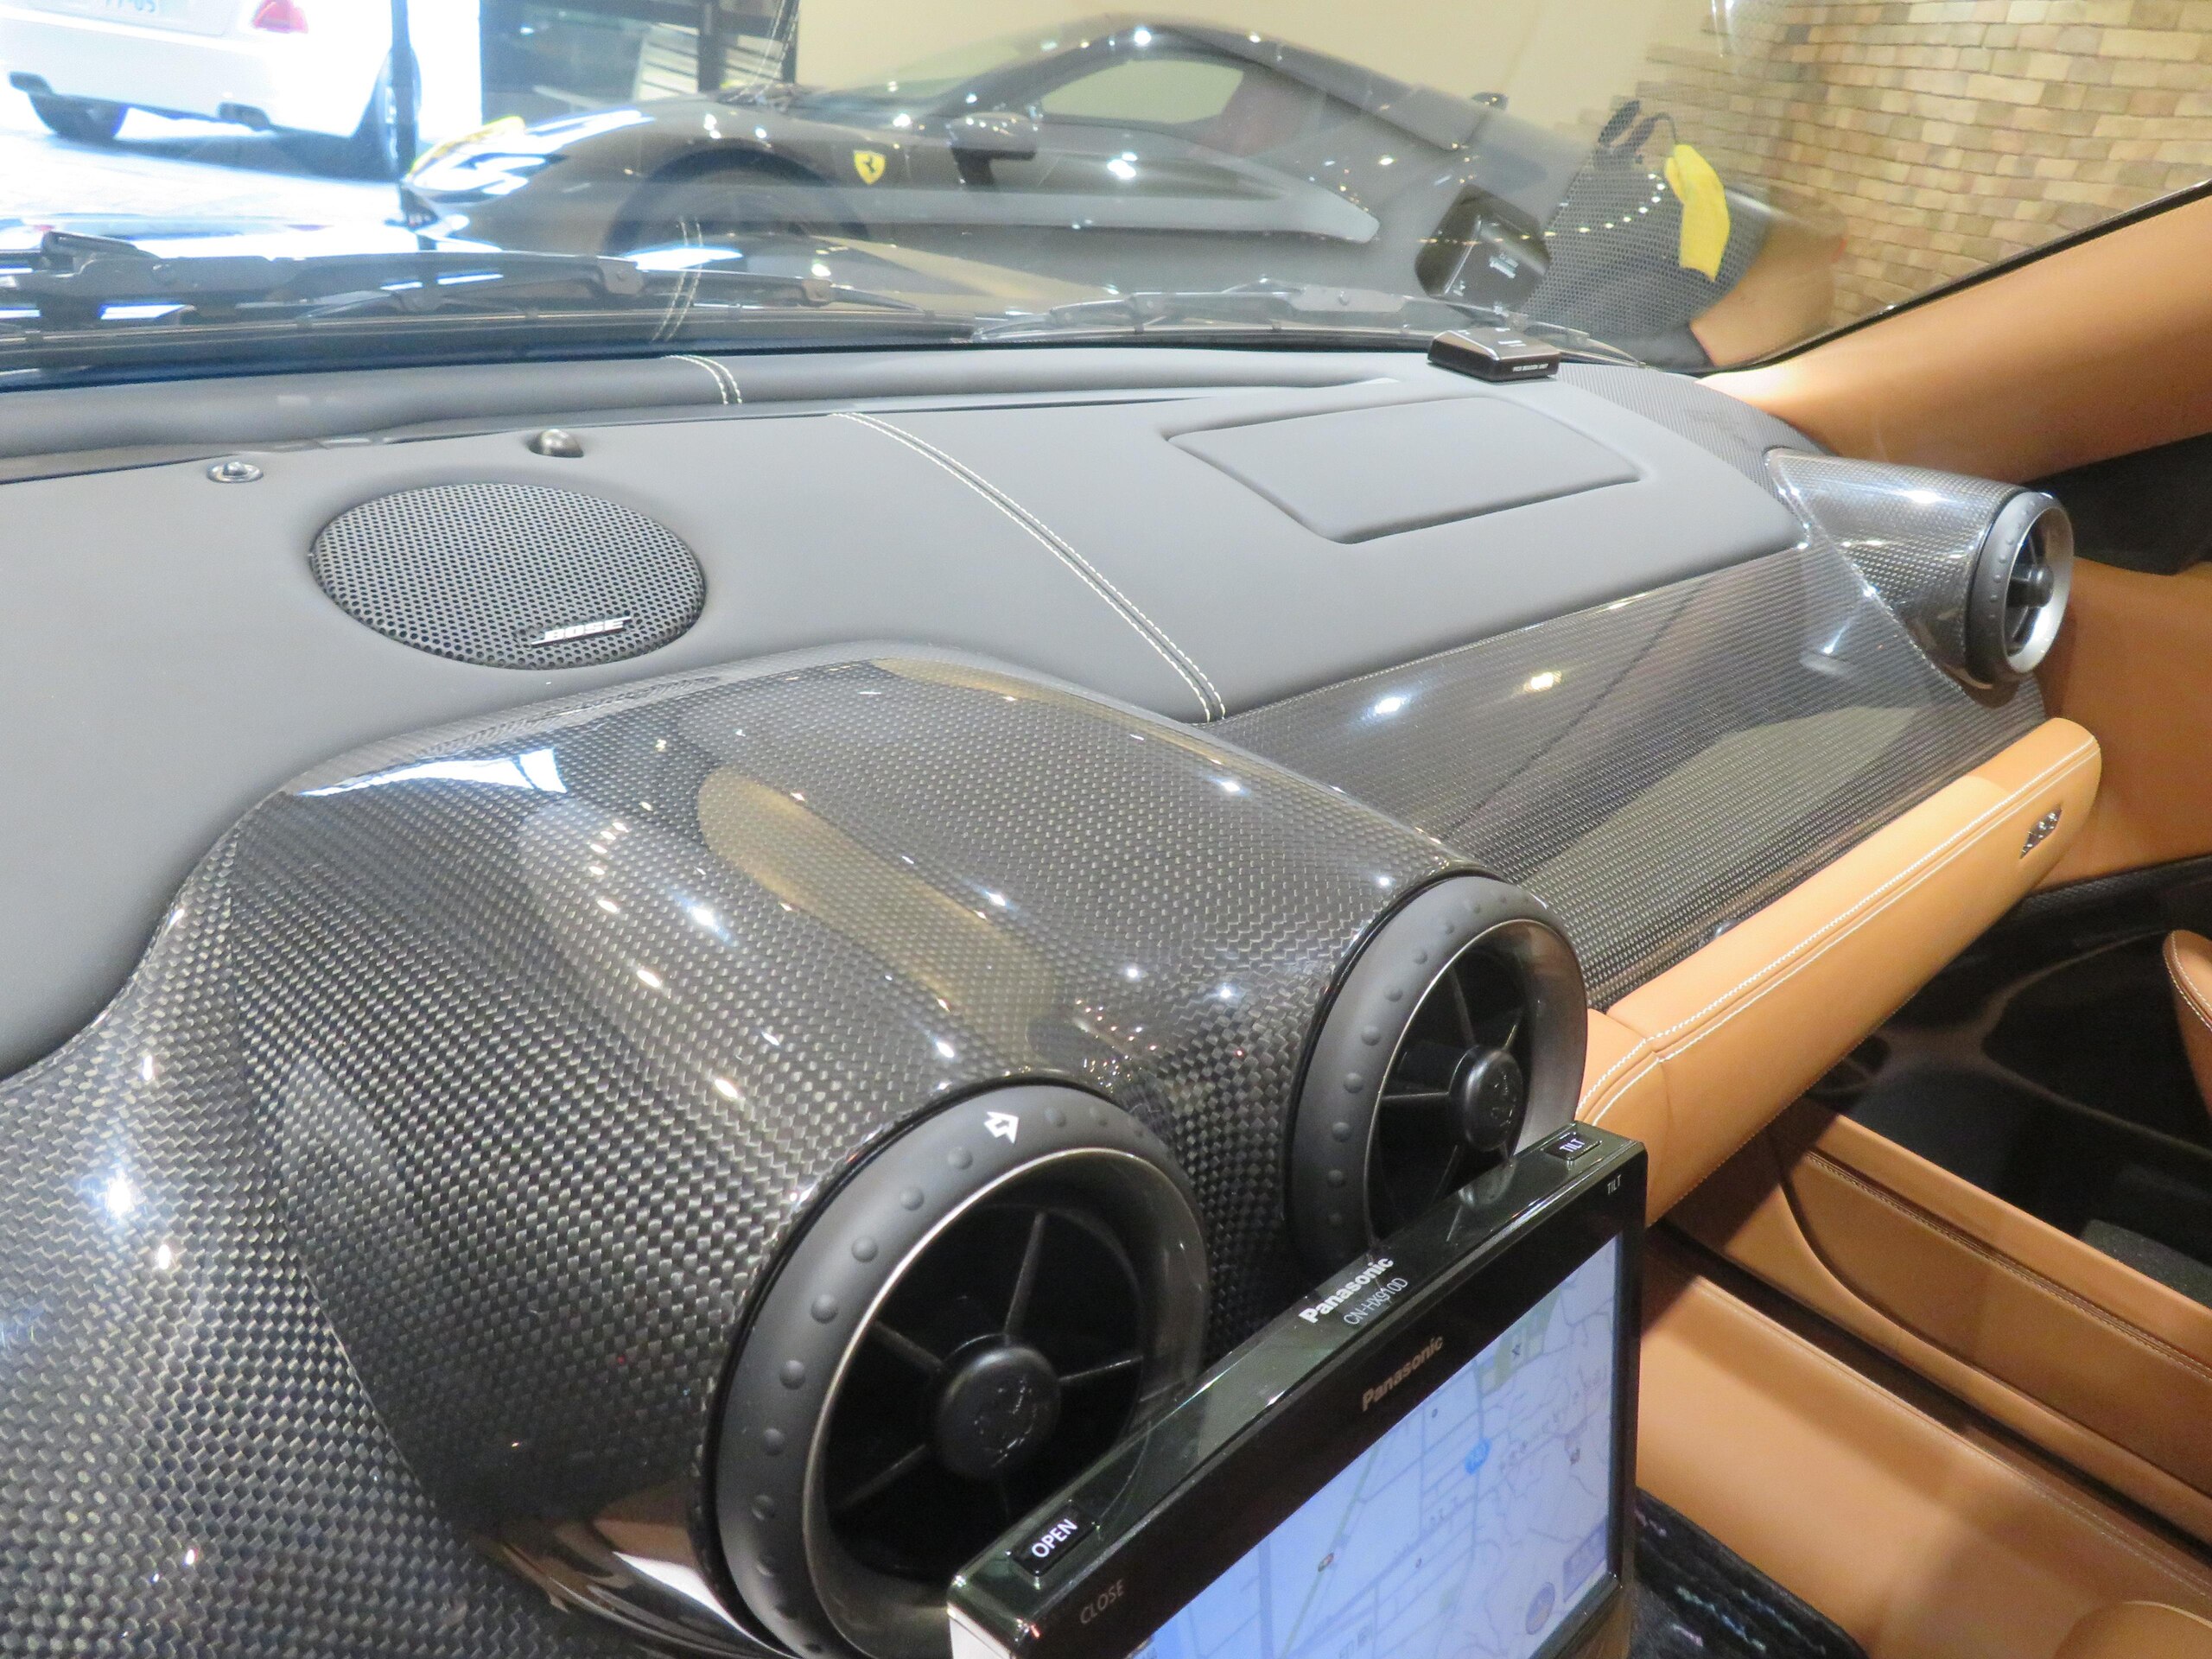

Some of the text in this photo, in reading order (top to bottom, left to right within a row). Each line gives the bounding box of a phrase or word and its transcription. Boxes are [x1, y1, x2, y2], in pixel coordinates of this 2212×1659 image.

[536, 617, 629, 644] BOSE
[1558, 1138, 1586, 1153] TILT
[1607, 1173, 1623, 1196] TILT
[1298, 1257, 1395, 1324] Panasonic
[1343, 1277, 1408, 1325] CN-HX910D
[1362, 1336, 1444, 1412] Panasonic
[1031, 1518, 1078, 1558] OPEN
[1079, 1579, 1125, 1624] CLOSE
